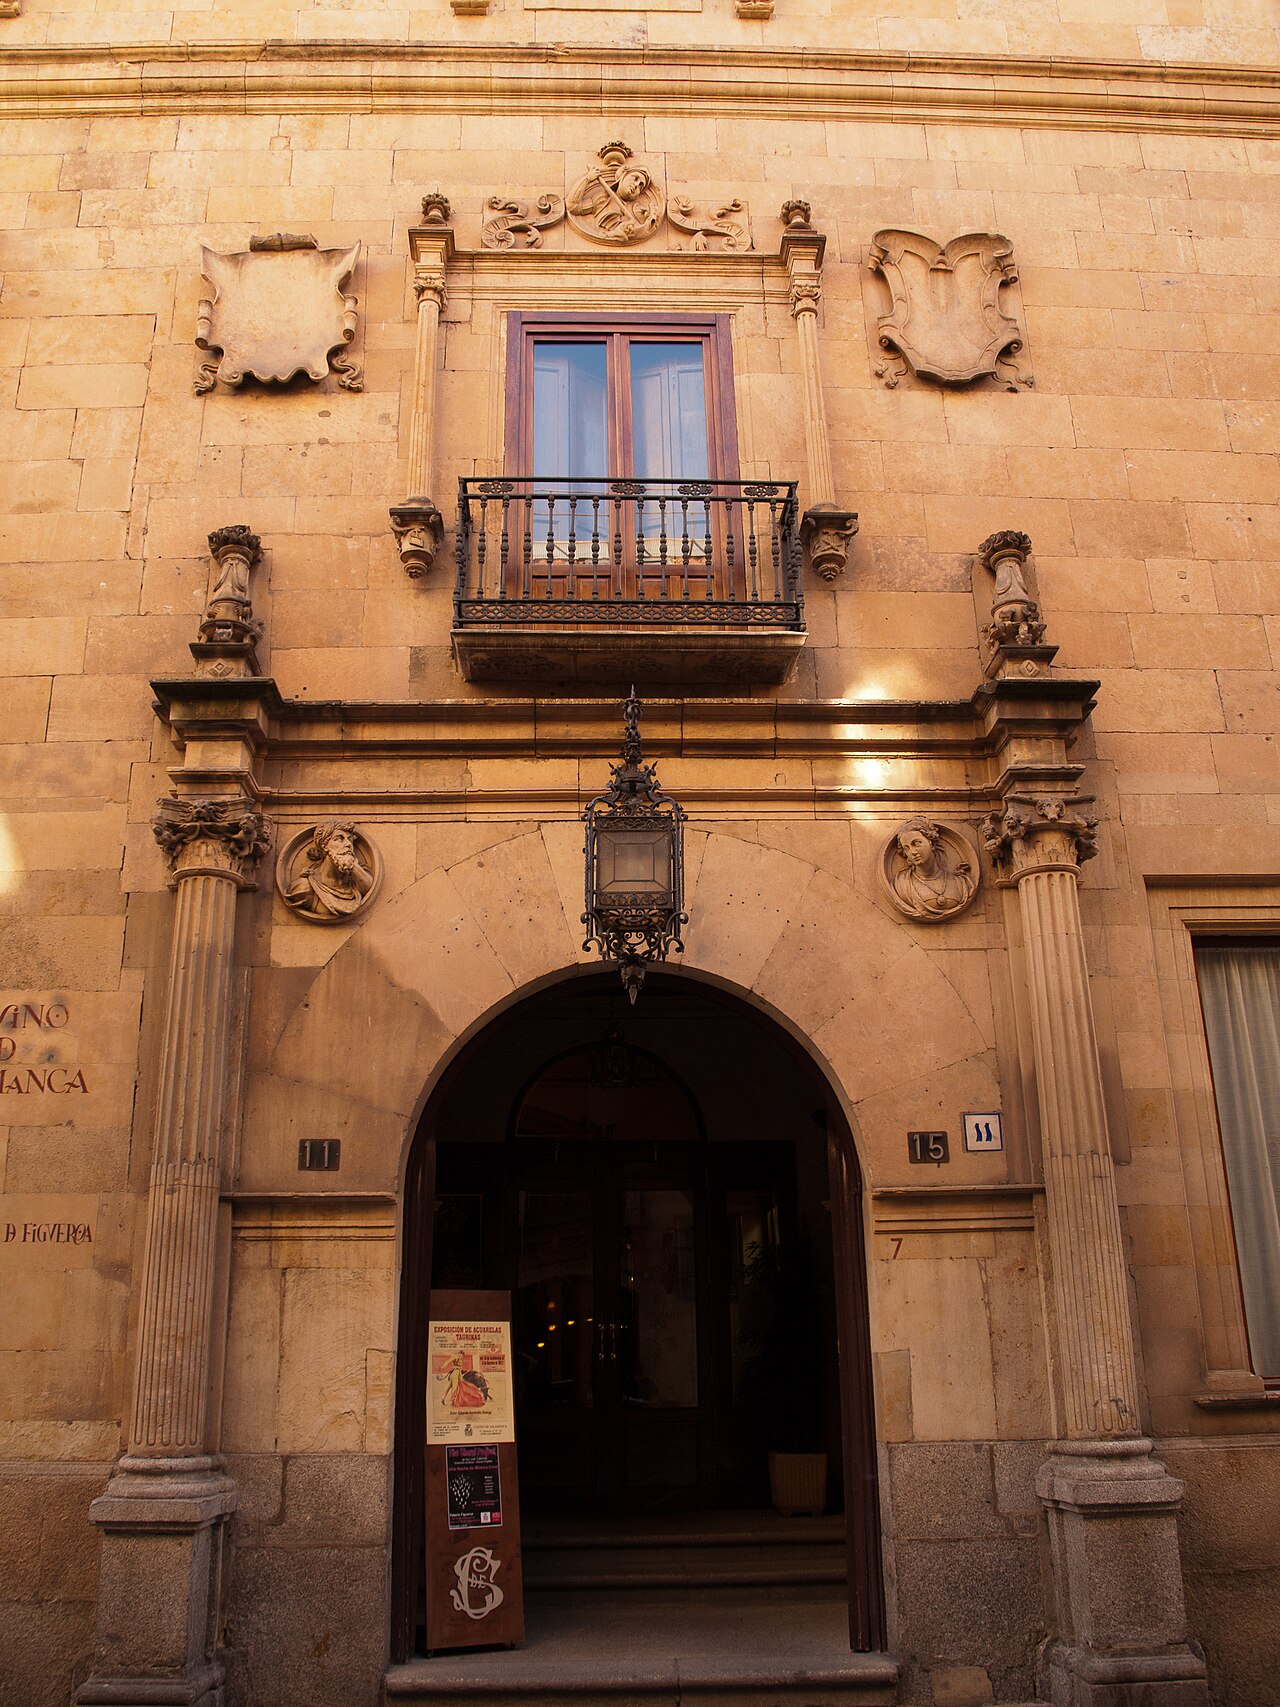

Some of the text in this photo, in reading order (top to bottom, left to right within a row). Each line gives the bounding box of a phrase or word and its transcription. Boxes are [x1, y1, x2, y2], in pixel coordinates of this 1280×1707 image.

[974, 1122, 993, 1142] 11
[304, 1141, 329, 1168] 11
[913, 1133, 944, 1160] 15
[890, 1238, 903, 1260] 7
